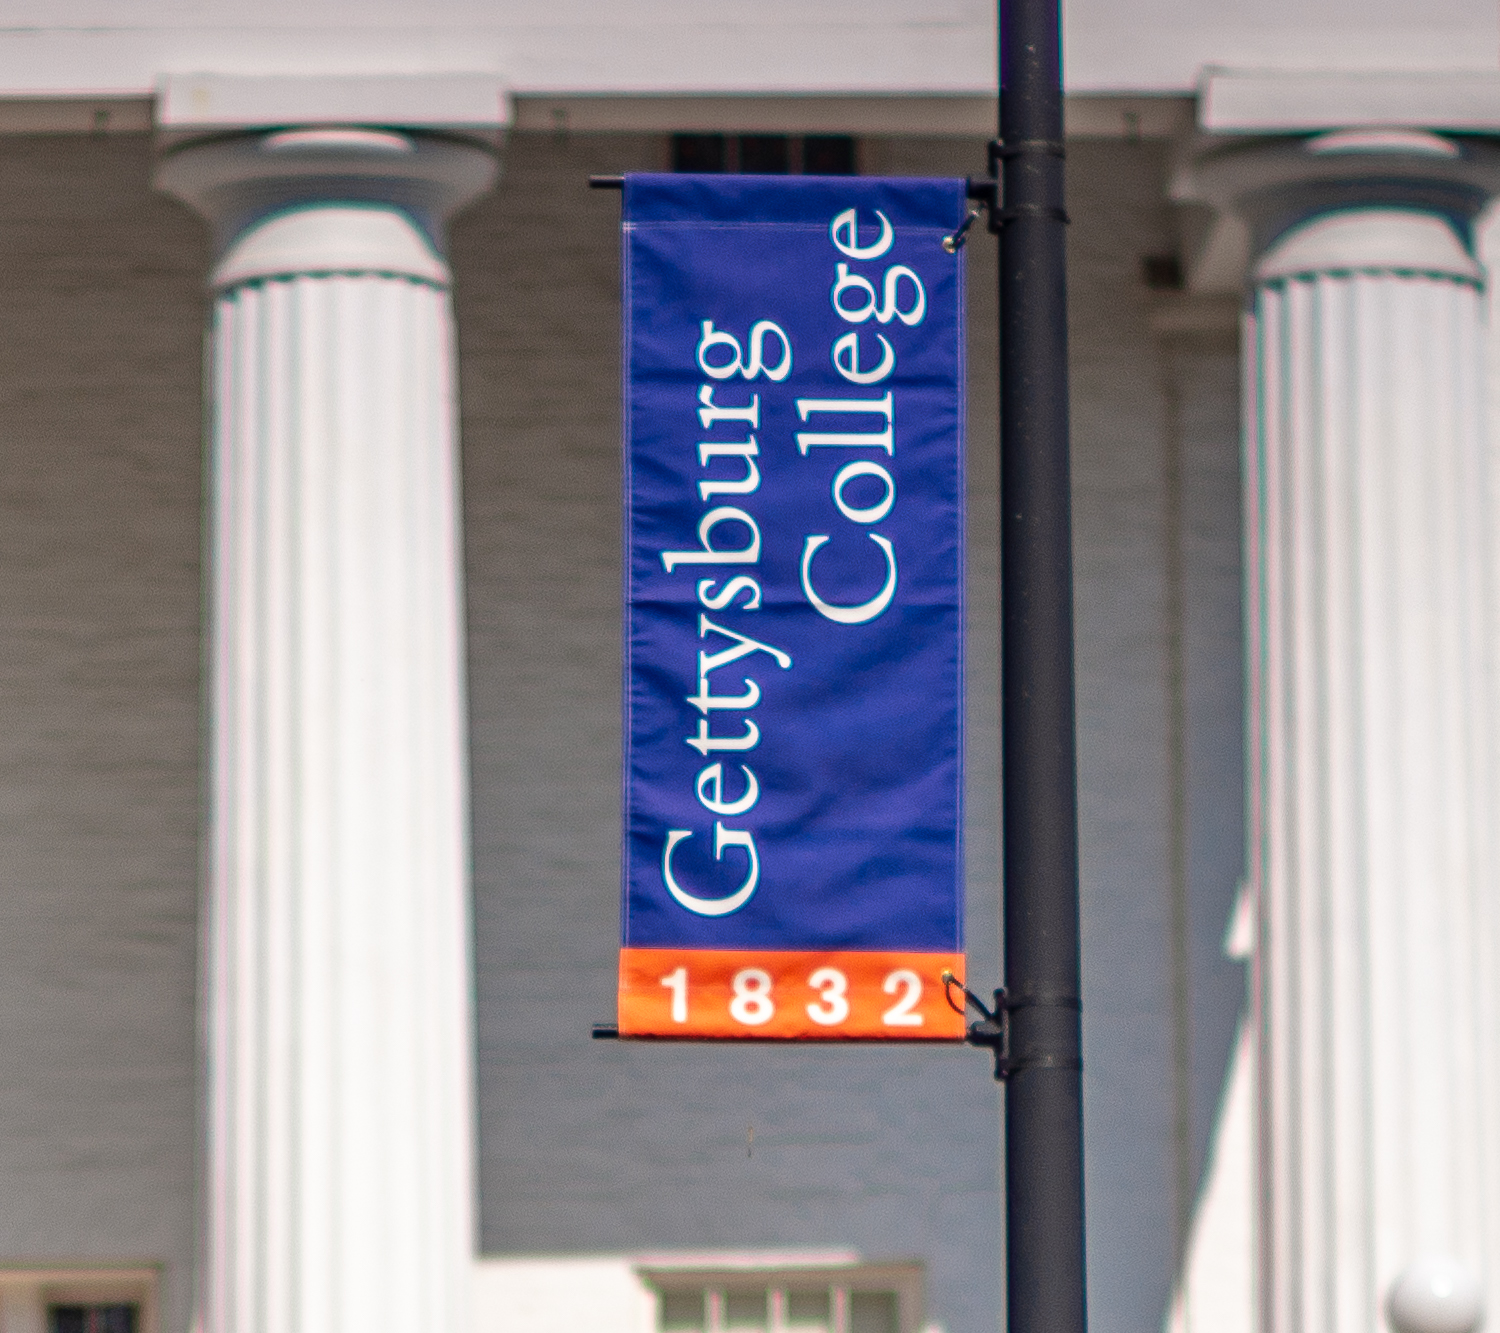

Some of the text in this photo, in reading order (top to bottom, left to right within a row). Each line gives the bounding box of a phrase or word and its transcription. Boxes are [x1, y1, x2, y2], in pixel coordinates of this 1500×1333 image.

[661, 318, 793, 917] Gettysburg
[796, 207, 927, 625] College
[660, 967, 924, 1027] 1832
